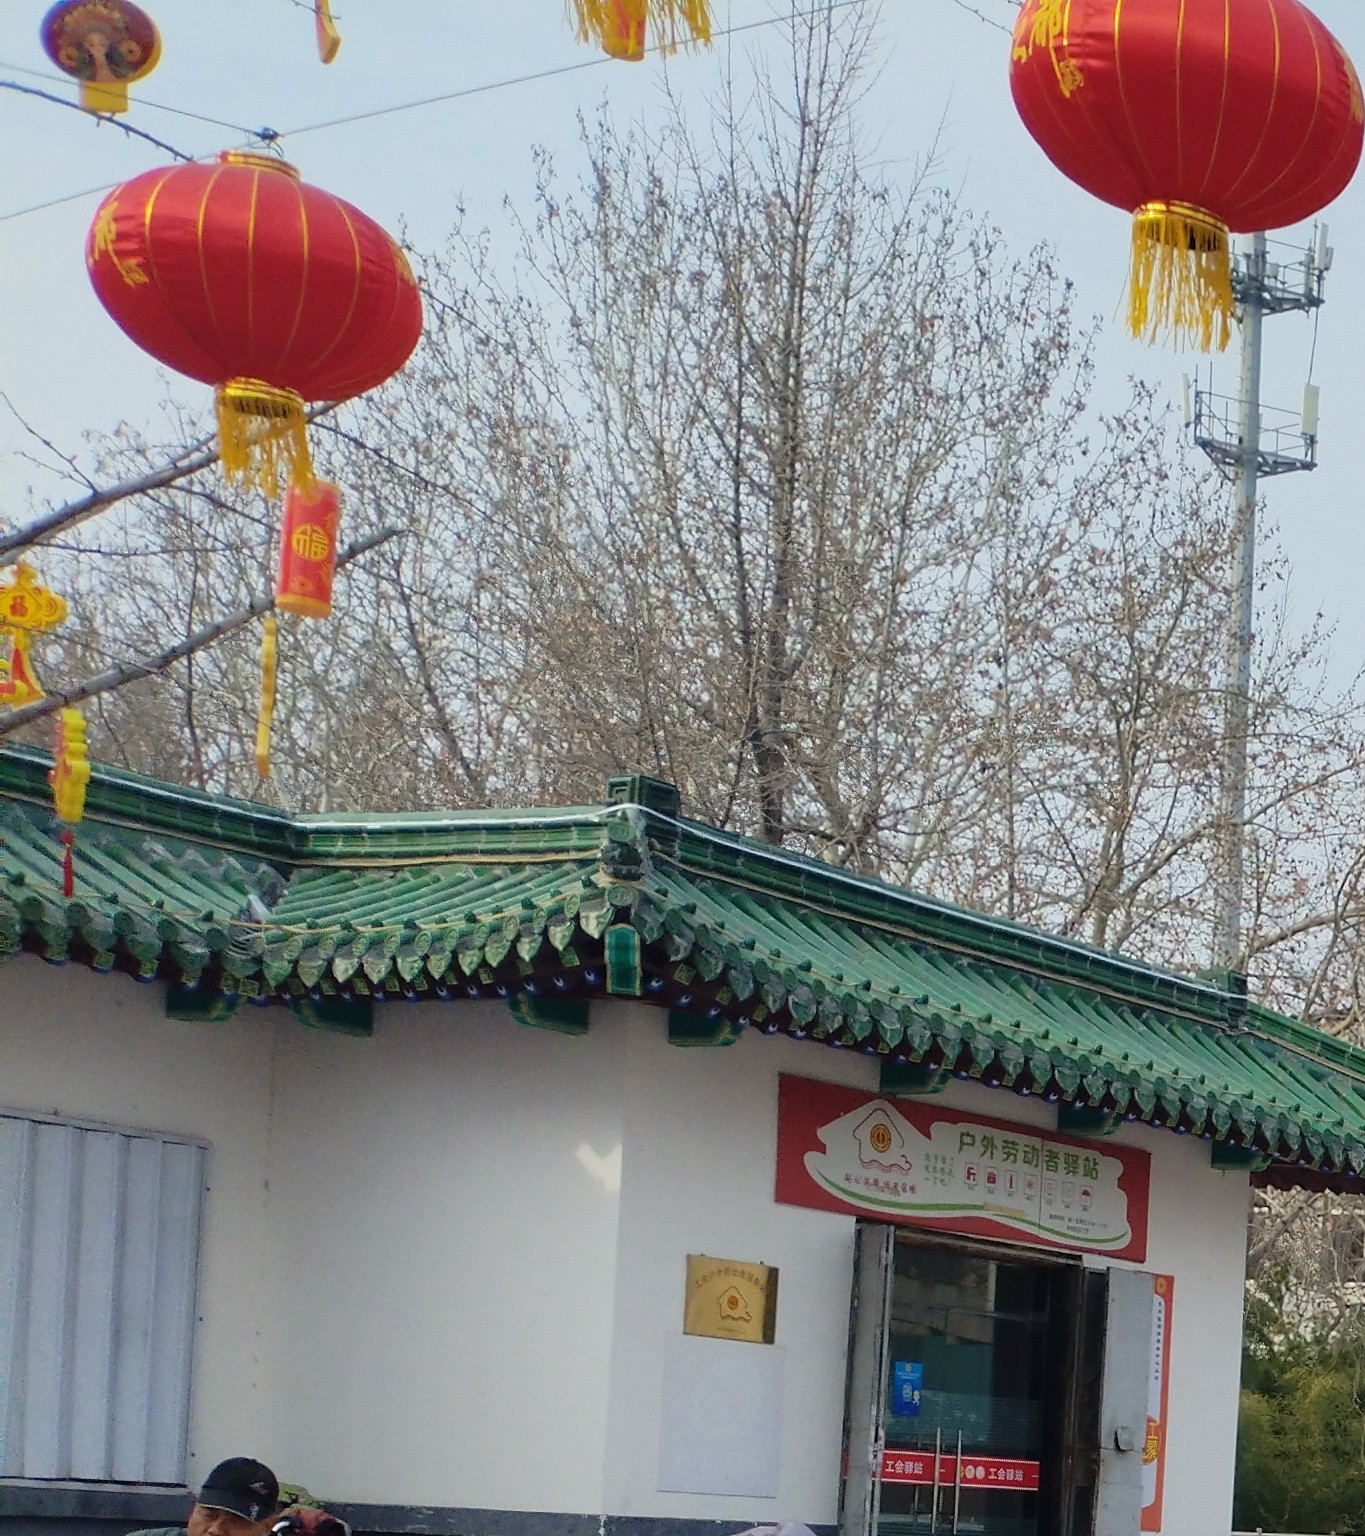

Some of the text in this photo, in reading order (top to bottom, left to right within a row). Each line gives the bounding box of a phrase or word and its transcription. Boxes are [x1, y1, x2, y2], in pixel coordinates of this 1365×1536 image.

[292, 523, 330, 562] 福
[957, 1131, 1099, 1180] 户外劳动者驿站
[885, 1459, 924, 1476] 工会驿站
[988, 1467, 1025, 1482] 工会驿站
